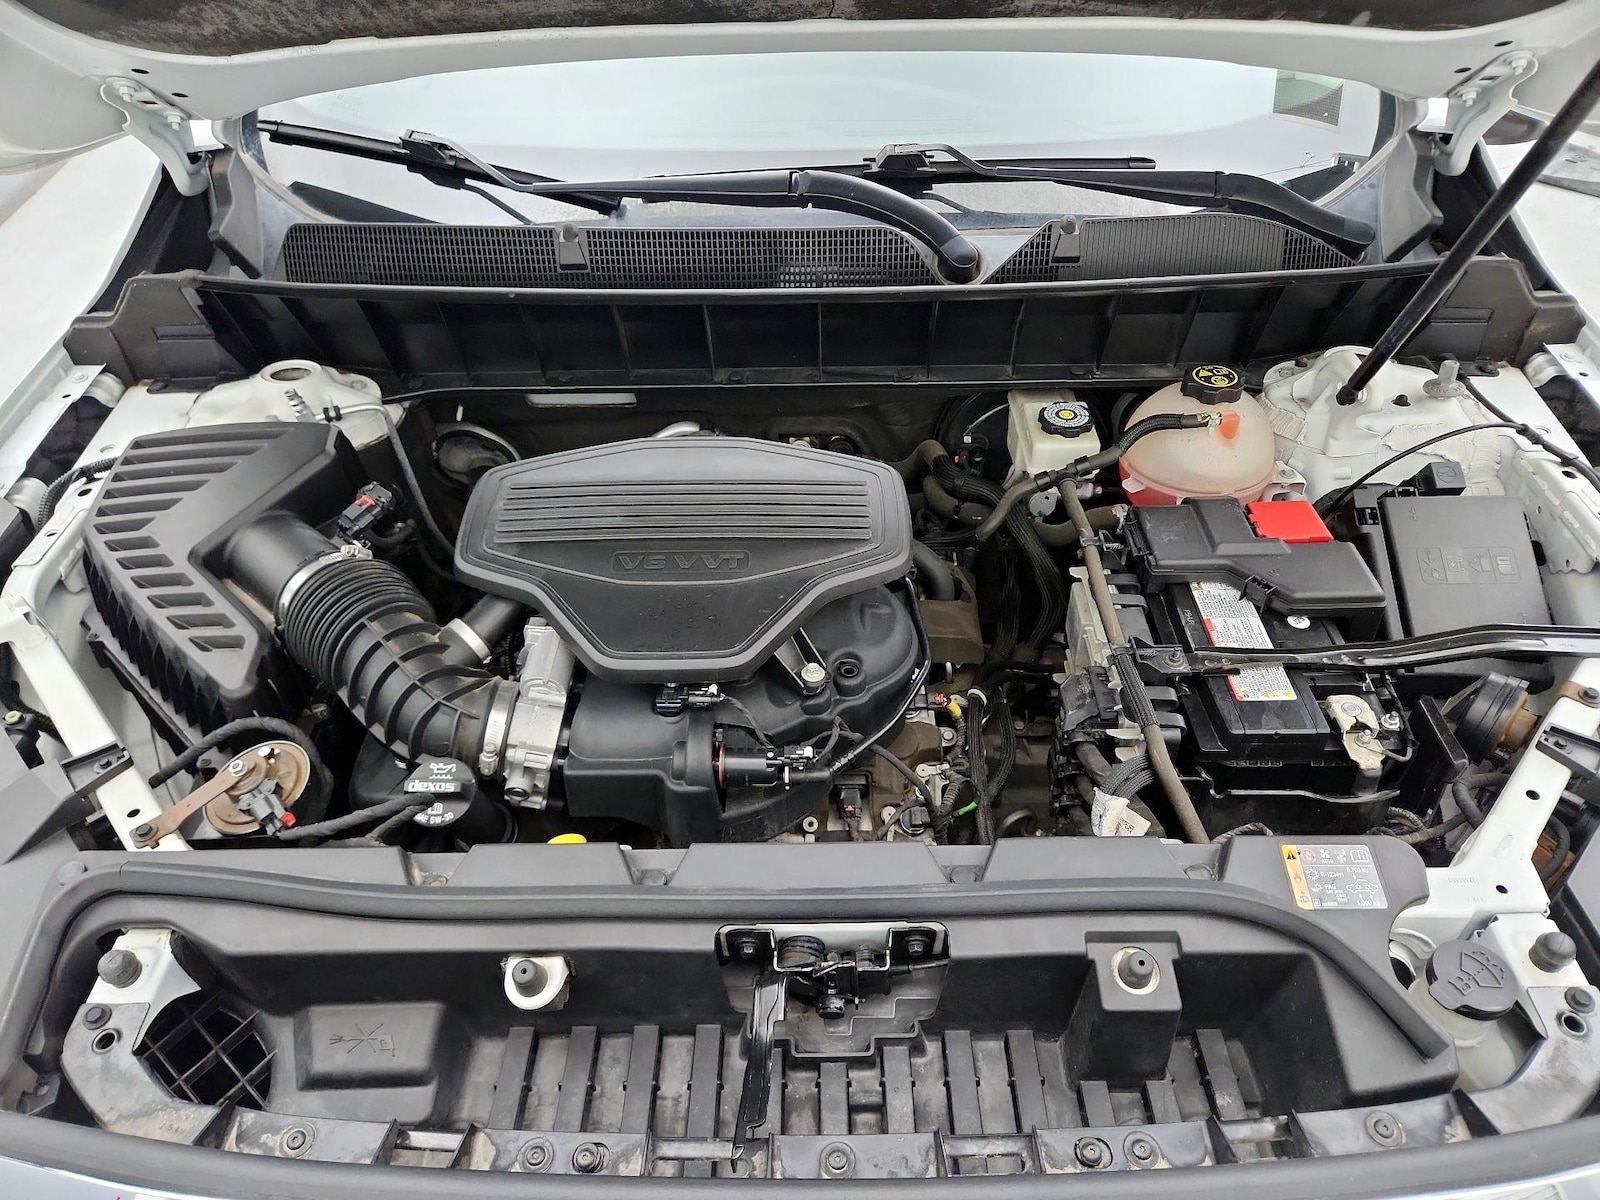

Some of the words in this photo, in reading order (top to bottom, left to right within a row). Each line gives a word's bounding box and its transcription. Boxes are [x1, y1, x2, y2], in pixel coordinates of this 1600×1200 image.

[618, 554, 666, 570] V6
[674, 554, 745, 570] VVT
[408, 780, 456, 792] dexos
[430, 812, 454, 825] 5W-30
